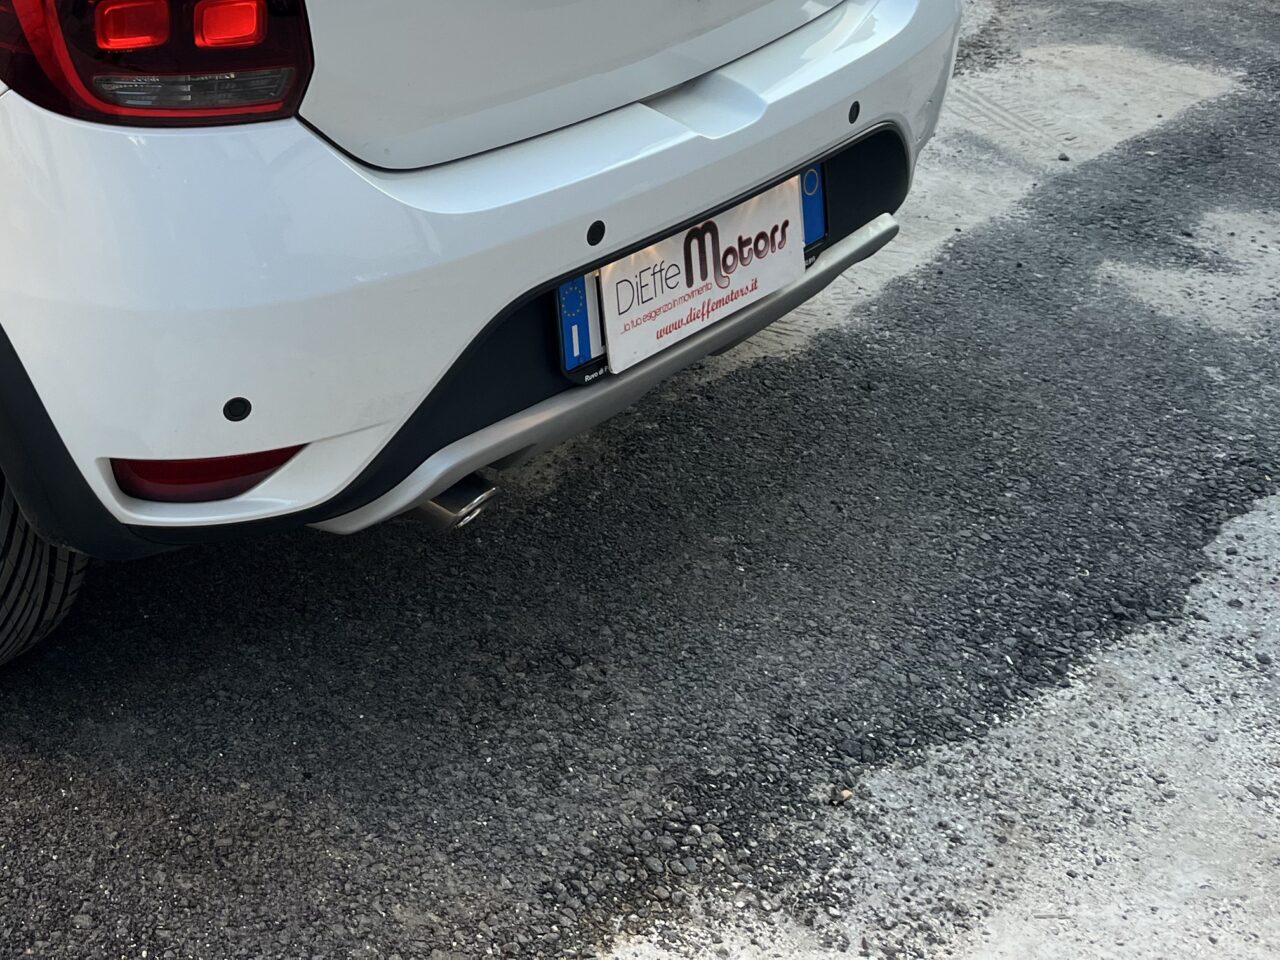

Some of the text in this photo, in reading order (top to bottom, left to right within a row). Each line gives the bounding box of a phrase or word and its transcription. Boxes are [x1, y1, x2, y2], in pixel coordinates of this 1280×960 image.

[615, 220, 790, 316] DiEffe Motors
[656, 277, 758, 340] www.dieffemotors.it
